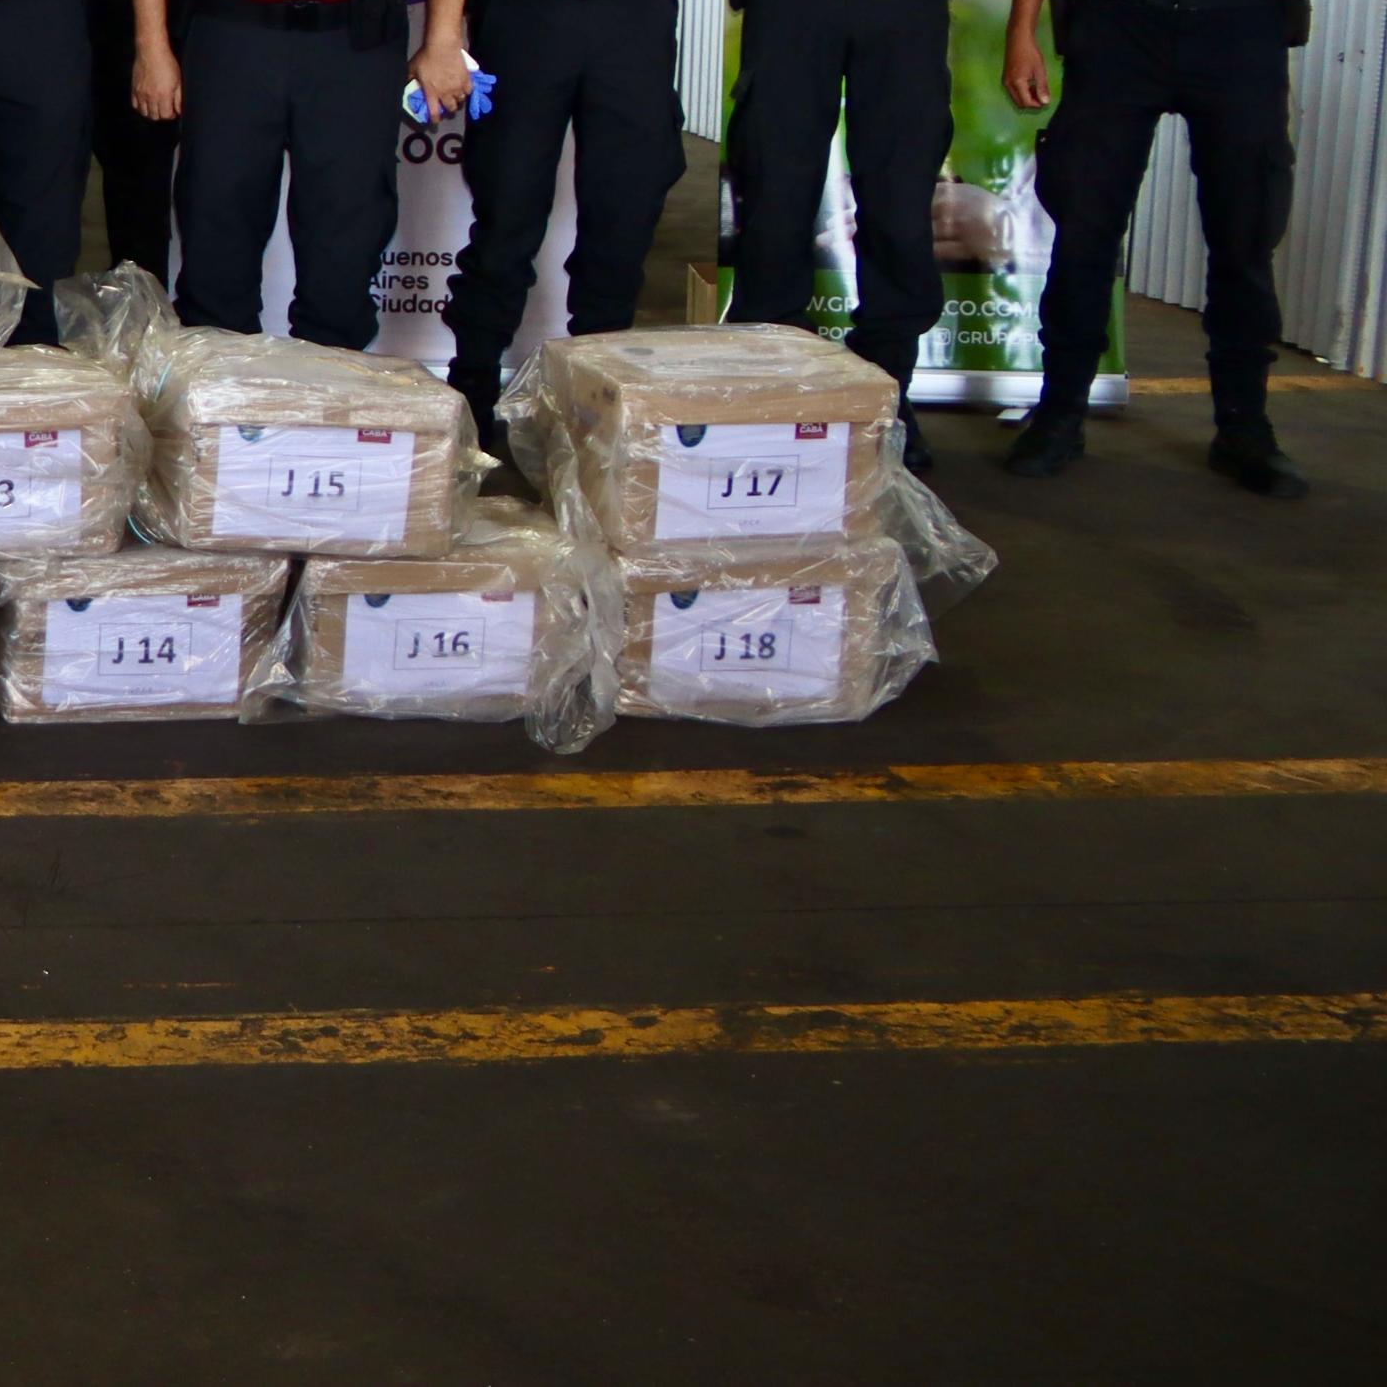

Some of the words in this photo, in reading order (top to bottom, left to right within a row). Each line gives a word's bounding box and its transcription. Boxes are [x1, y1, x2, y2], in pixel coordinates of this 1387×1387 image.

[381, 251, 454, 267] uenos
[28, 433, 55, 442] CABA
[799, 426, 825, 434] CABA
[281, 470, 295, 498] J
[307, 470, 346, 499] 15
[721, 471, 735, 498] J
[745, 469, 784, 497] 17
[112, 636, 125, 665] J
[137, 635, 178, 666] 14
[407, 631, 420, 659] J
[433, 630, 471, 659] 16
[714, 633, 728, 661] J
[738, 632, 777, 660] 18
